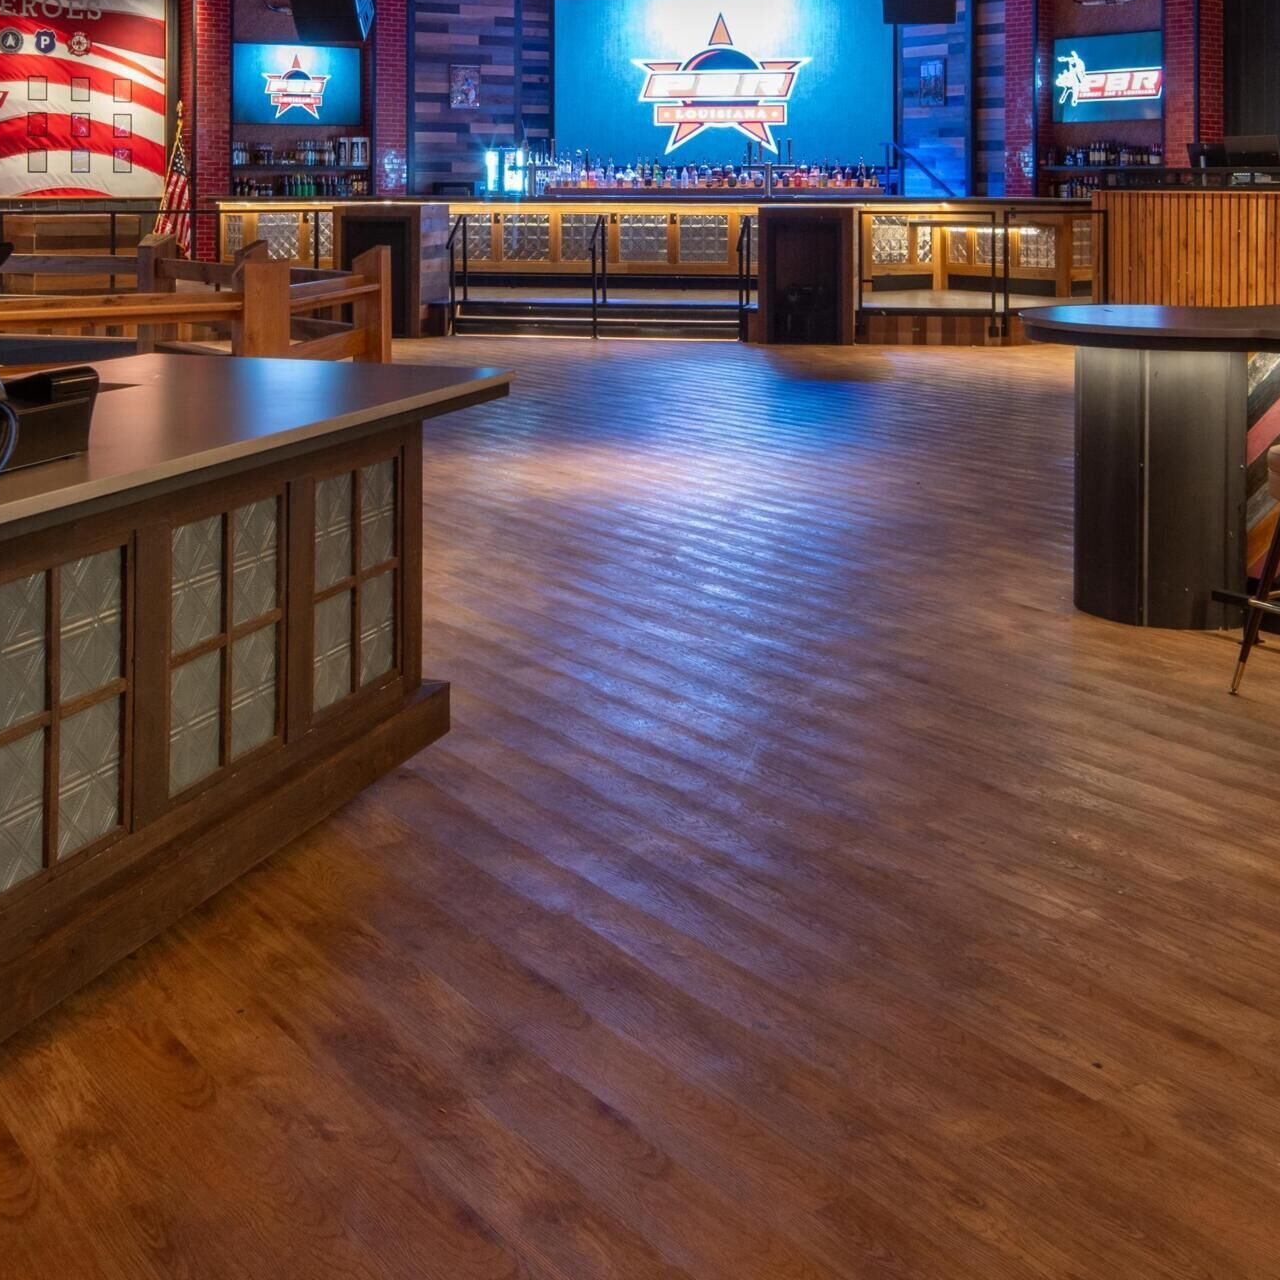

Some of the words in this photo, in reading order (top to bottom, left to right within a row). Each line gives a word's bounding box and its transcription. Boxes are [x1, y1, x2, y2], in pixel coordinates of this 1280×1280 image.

[41, 36, 50, 49] P
[652, 74, 787, 97] PBR
[1083, 71, 1160, 91] PBR
[675, 109, 768, 120] LOUISIANA
